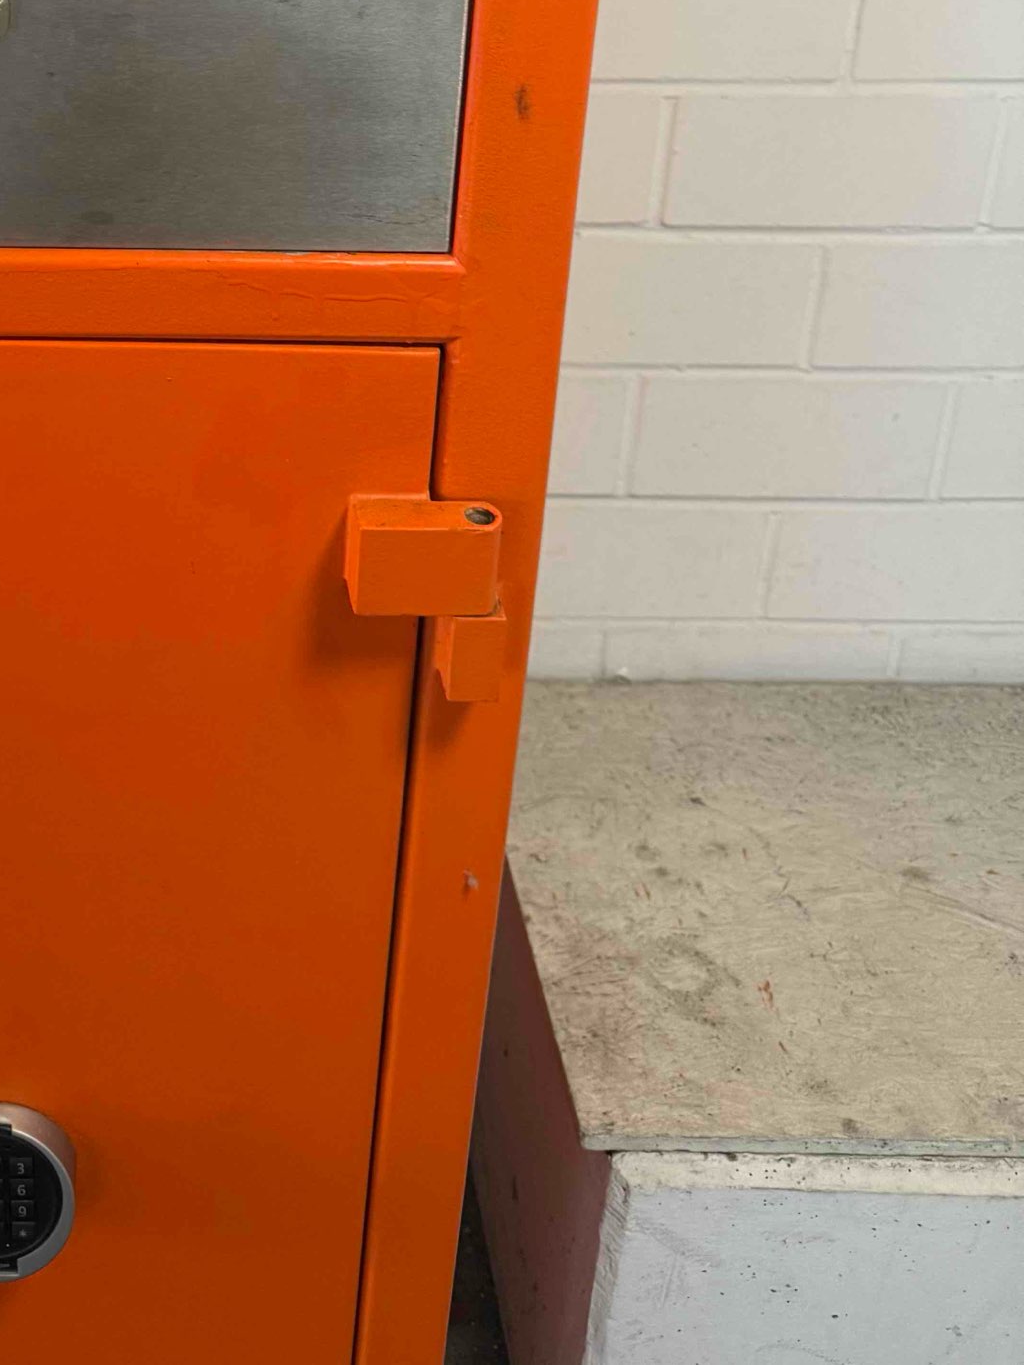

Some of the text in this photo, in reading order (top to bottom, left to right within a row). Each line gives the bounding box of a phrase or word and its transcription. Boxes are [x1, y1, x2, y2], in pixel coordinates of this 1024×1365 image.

[16, 1162, 25, 1175] 3
[17, 1184, 26, 1196] 6
[18, 1205, 27, 1217] 9
